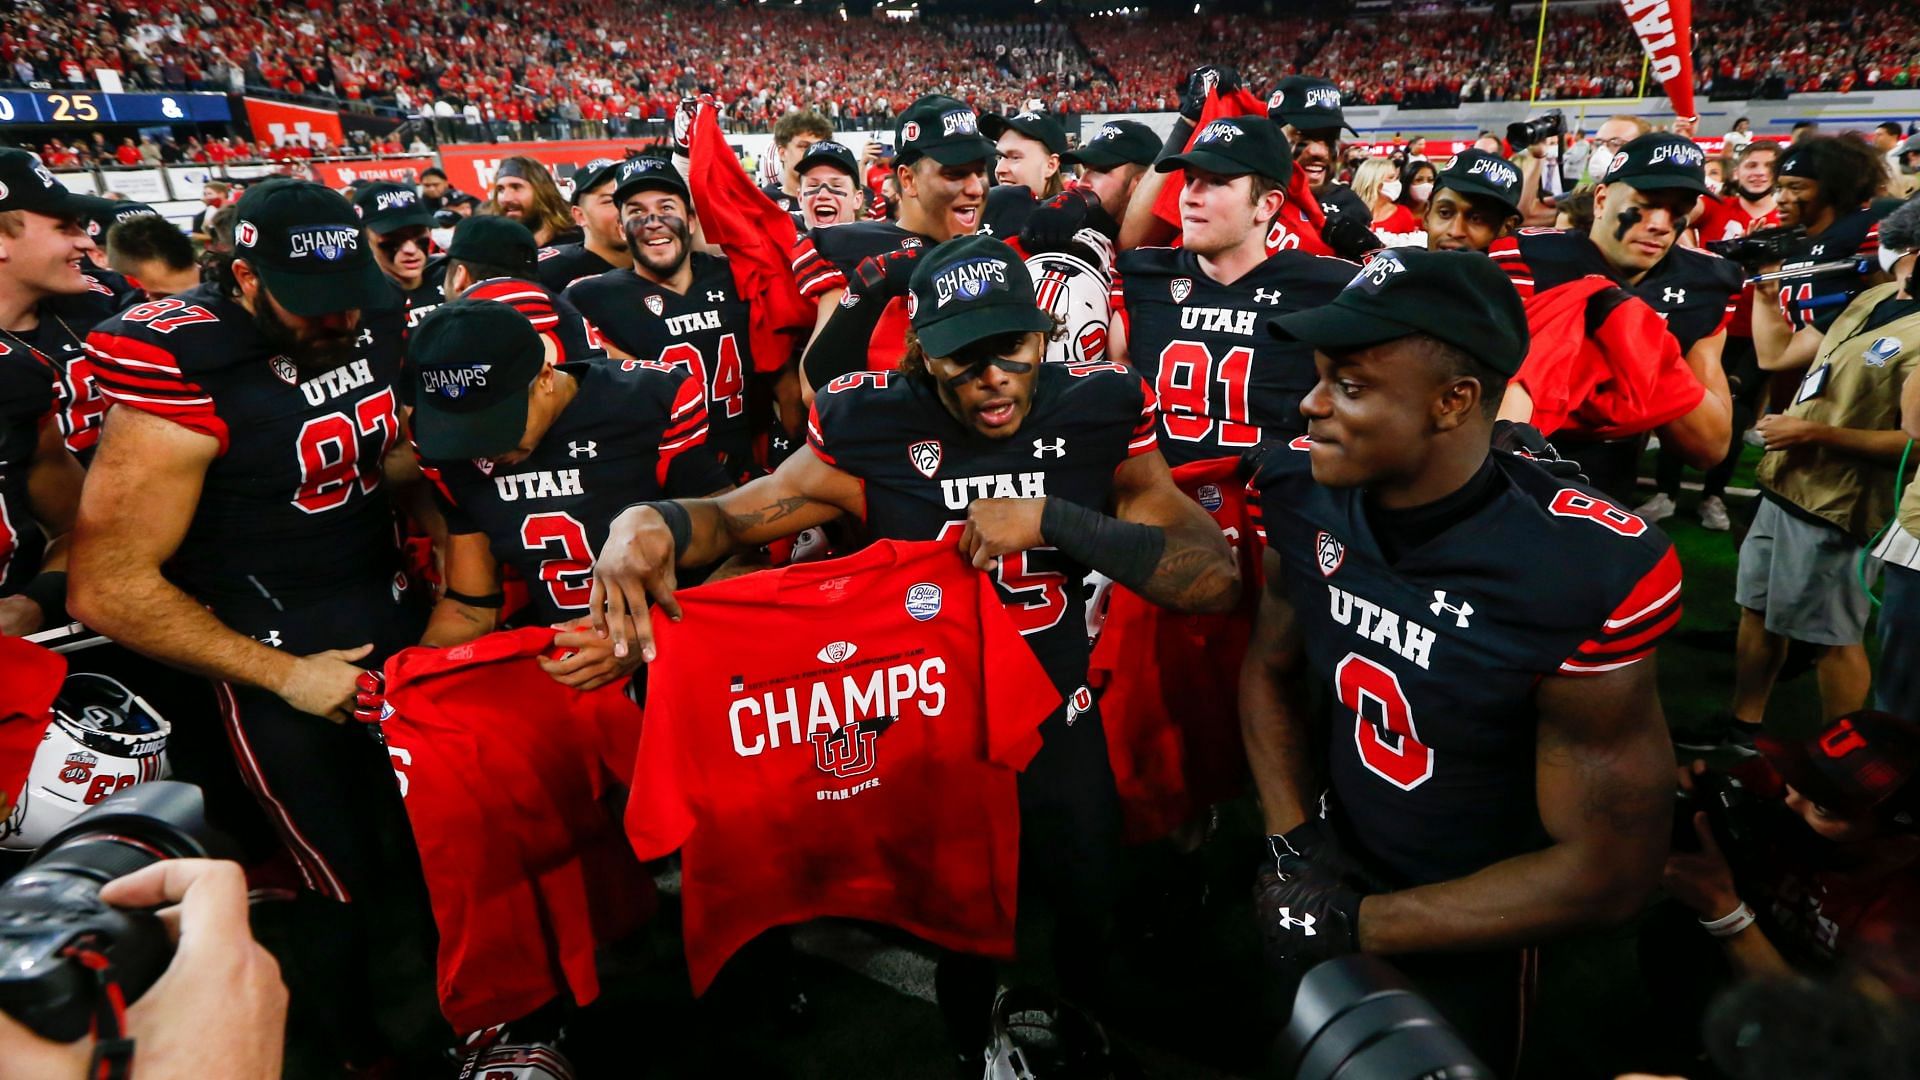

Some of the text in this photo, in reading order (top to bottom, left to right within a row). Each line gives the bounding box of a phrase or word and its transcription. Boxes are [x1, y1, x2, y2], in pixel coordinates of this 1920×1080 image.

[47, 95, 99, 121] 25
[161, 97, 183, 118] &
[242, 225, 255, 244] U
[290, 229, 359, 258] CHAMPS
[935, 260, 1006, 300] CHAMPS
[1174, 288, 1186, 299] 12
[121, 298, 220, 334] 87
[664, 310, 722, 336] UTAH
[1180, 306, 1257, 336] UTAH
[281, 366, 296, 380] 12
[300, 358, 375, 407] UTAH
[421, 366, 490, 393] CHAMPS
[1155, 339, 1262, 447] 81
[291, 384, 400, 514] 87
[911, 442, 941, 464] PAC
[919, 457, 936, 471] 12
[494, 469, 585, 502] UTAH
[940, 471, 1047, 510] UTAH
[1548, 488, 1649, 538] 8
[520, 511, 598, 610] 2
[1319, 534, 1344, 563] PAC
[1321, 552, 1335, 569] 12
[1328, 585, 1437, 670] UTAH
[729, 656, 946, 757] CHAMPS
[1075, 689, 1089, 710] U
[1819, 719, 1867, 759] U
